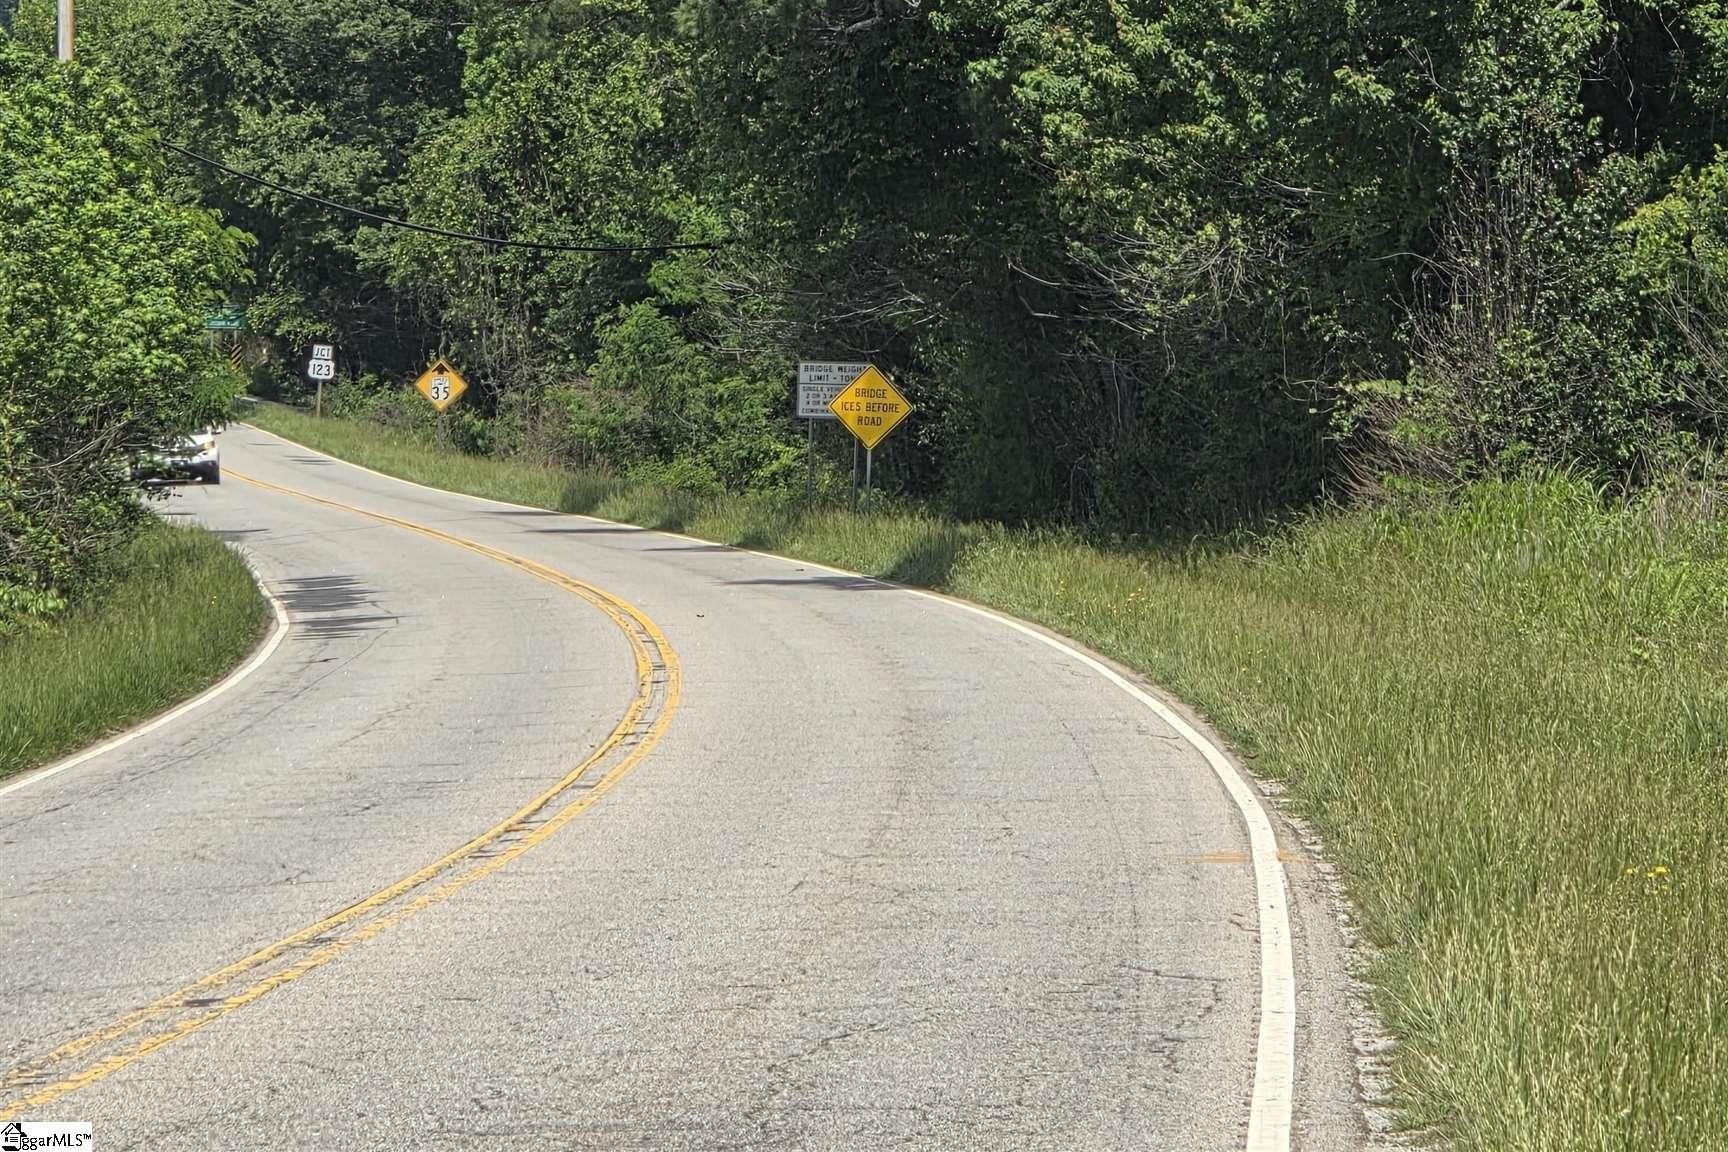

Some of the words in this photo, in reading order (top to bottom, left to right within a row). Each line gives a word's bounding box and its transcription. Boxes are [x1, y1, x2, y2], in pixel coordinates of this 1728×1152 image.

[315, 345, 331, 358] JCT
[312, 363, 331, 377] 123
[804, 364, 833, 373] BRIDGE
[809, 374, 829, 382] LIMIT
[431, 386, 449, 401] 35
[855, 388, 888, 399] BRIDGE
[841, 401, 861, 412] ICES
[865, 402, 900, 414] BEFORE
[857, 416, 882, 427] ROAD
